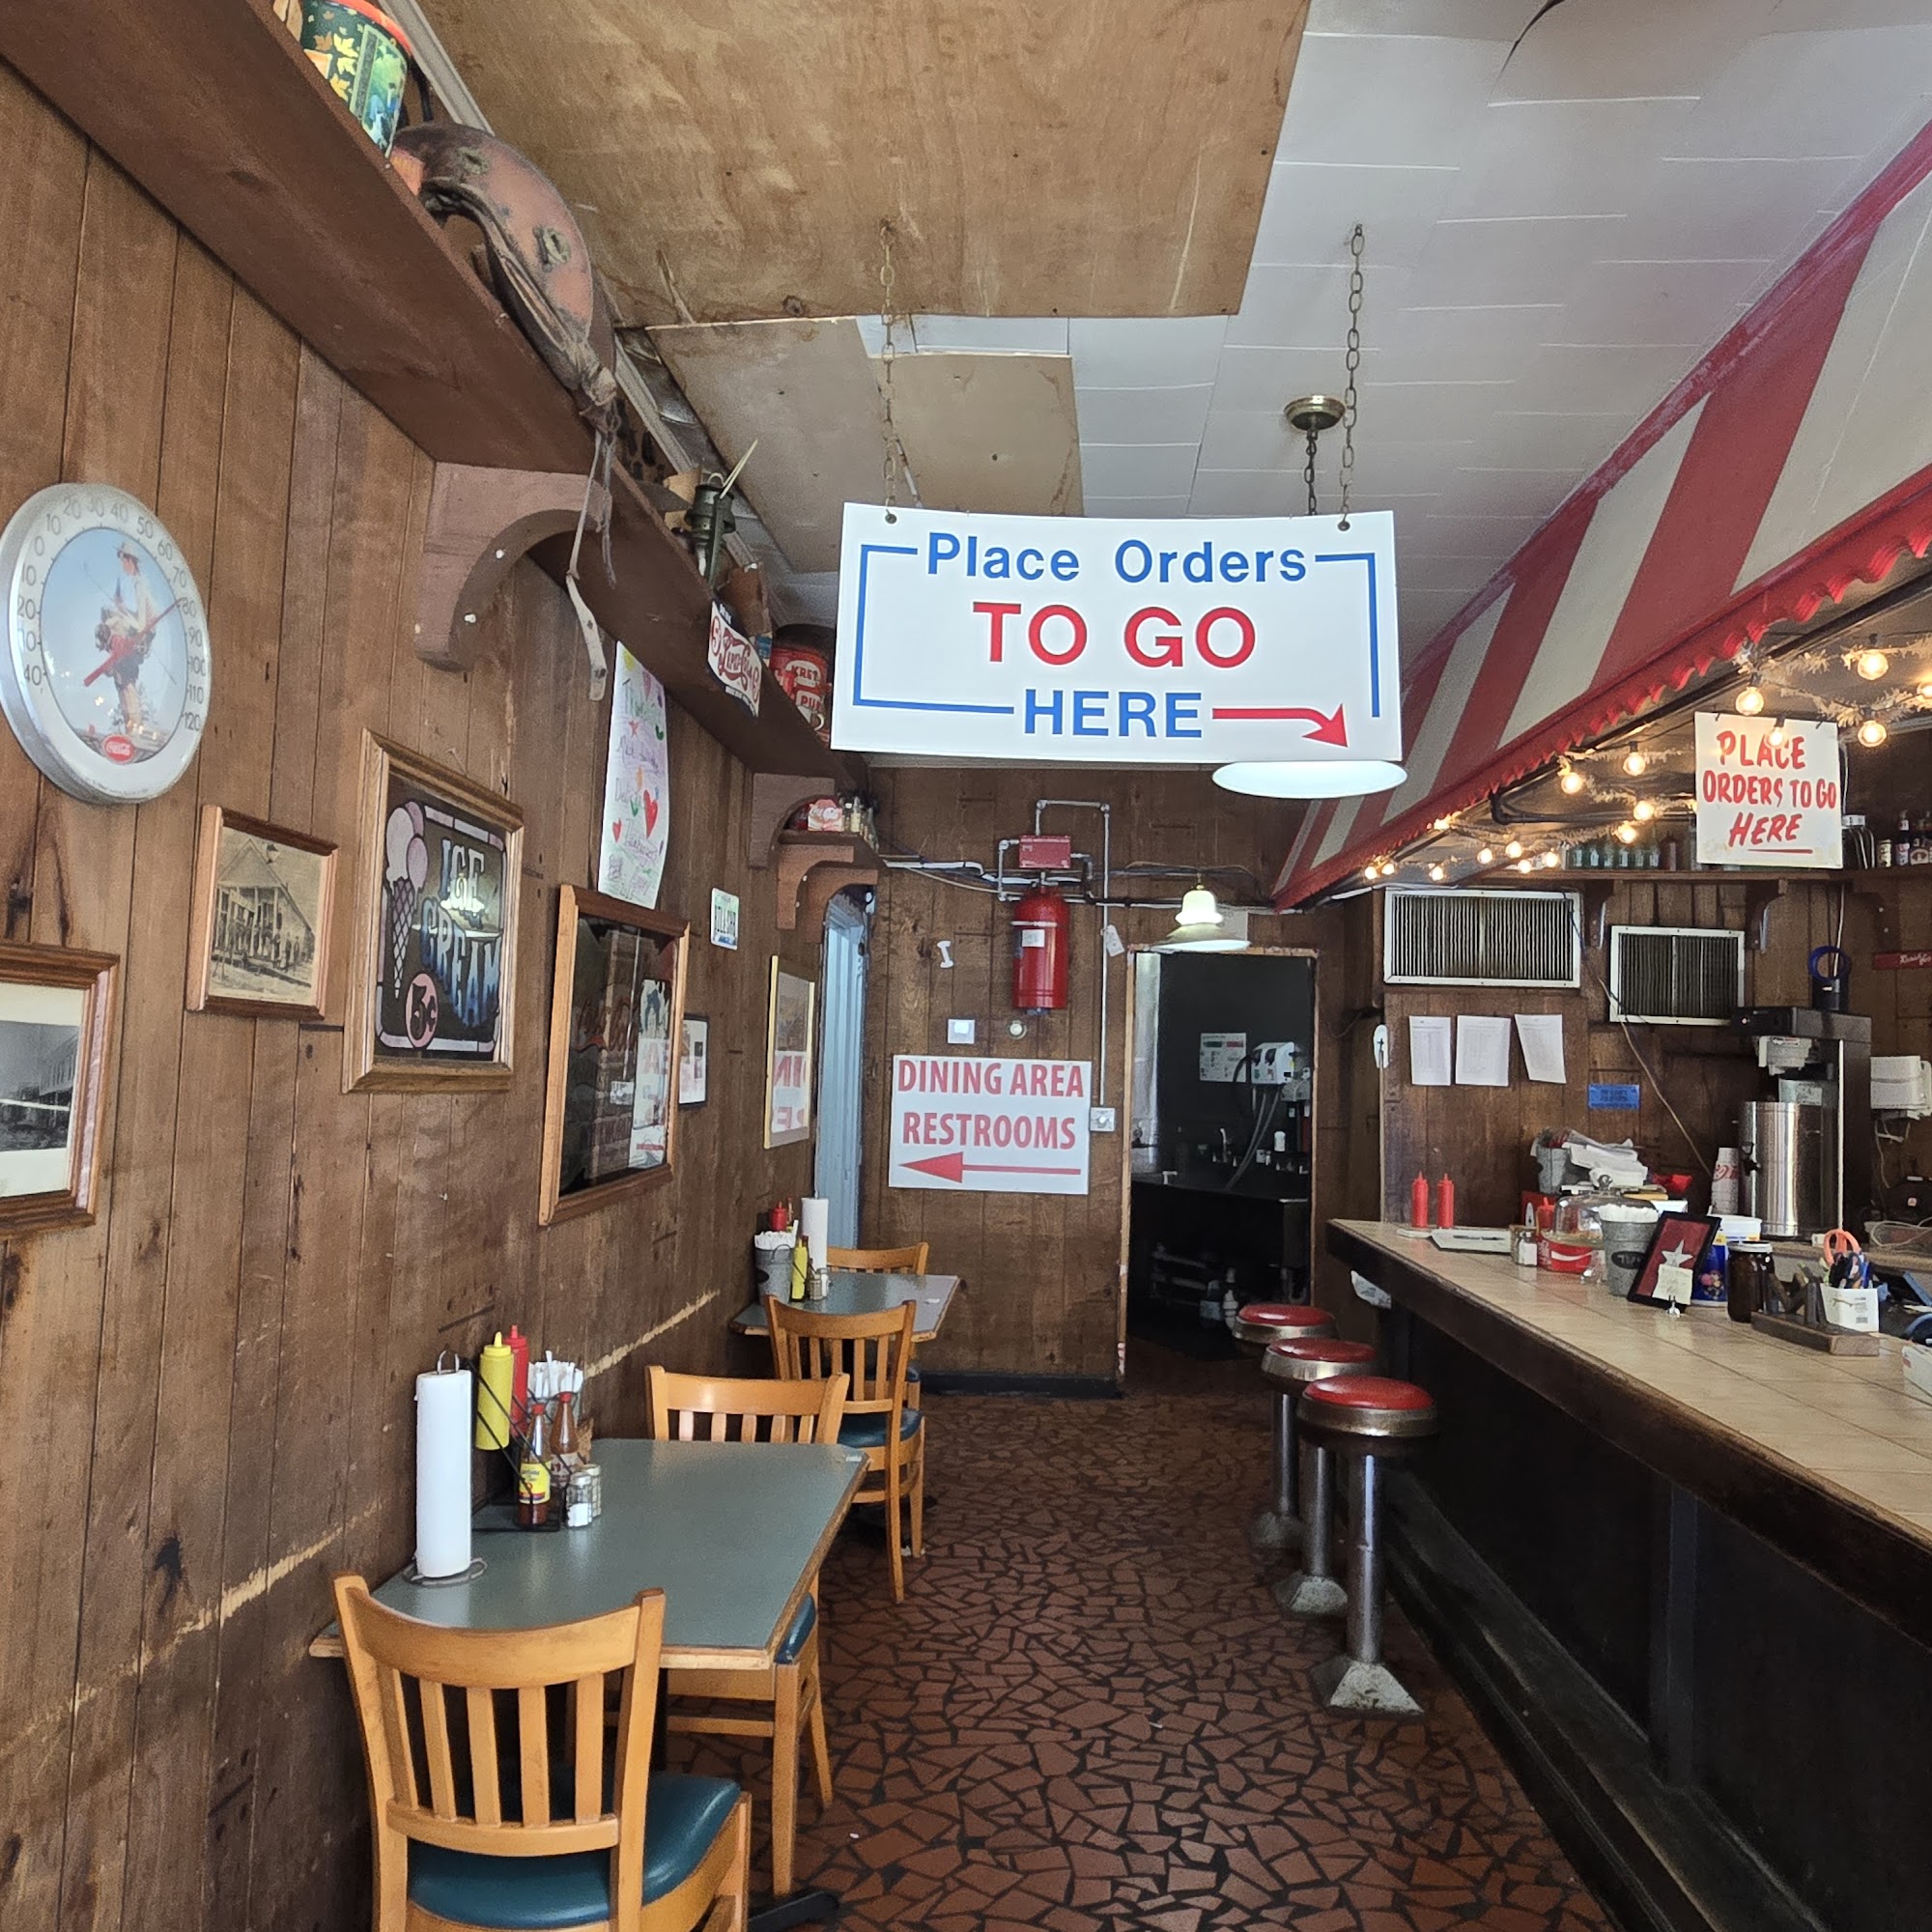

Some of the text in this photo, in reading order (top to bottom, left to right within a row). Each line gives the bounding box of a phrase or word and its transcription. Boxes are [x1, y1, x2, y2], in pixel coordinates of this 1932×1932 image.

[927, 532, 1307, 582] Place Orders
[34, 535, 45, 556] 0
[136, 516, 154, 539] 50
[157, 539, 173, 561] 60
[173, 566, 187, 588] 70
[188, 684, 204, 704] 110
[973, 601, 1256, 668] TO GO
[1024, 689, 1203, 738] HERE
[1717, 730, 1805, 769] PLACE
[1703, 770, 1836, 809] ORDERS TO GO
[1728, 811, 1803, 847] HERE
[440, 838, 484, 928] ICE
[420, 896, 502, 1028] CREAM
[897, 1060, 1084, 1097] DINING AREA
[902, 1112, 1076, 1150] RESTROOMS
